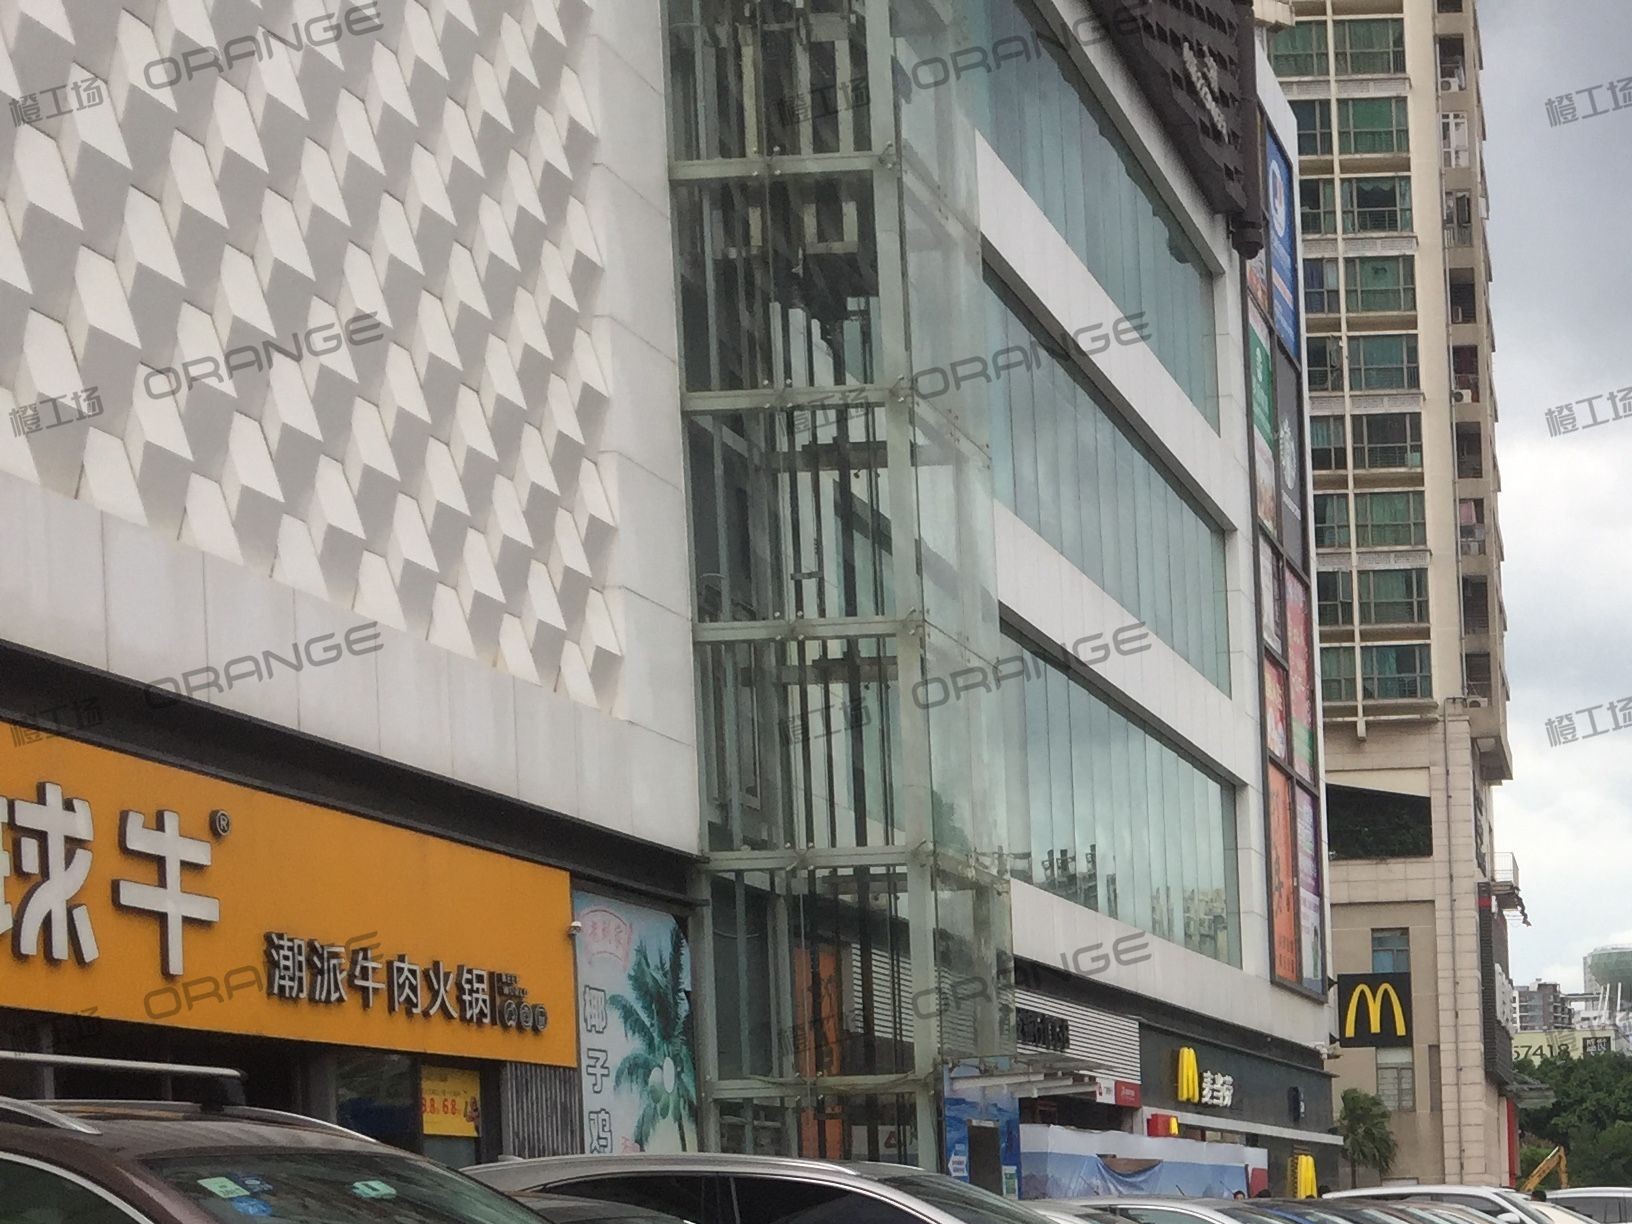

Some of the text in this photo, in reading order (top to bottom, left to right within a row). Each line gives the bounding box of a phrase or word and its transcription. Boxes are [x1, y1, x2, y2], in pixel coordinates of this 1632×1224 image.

[267, 933, 490, 1025] 潮派牛肉火锅
[1201, 1070, 1234, 1108] 麦当劳
